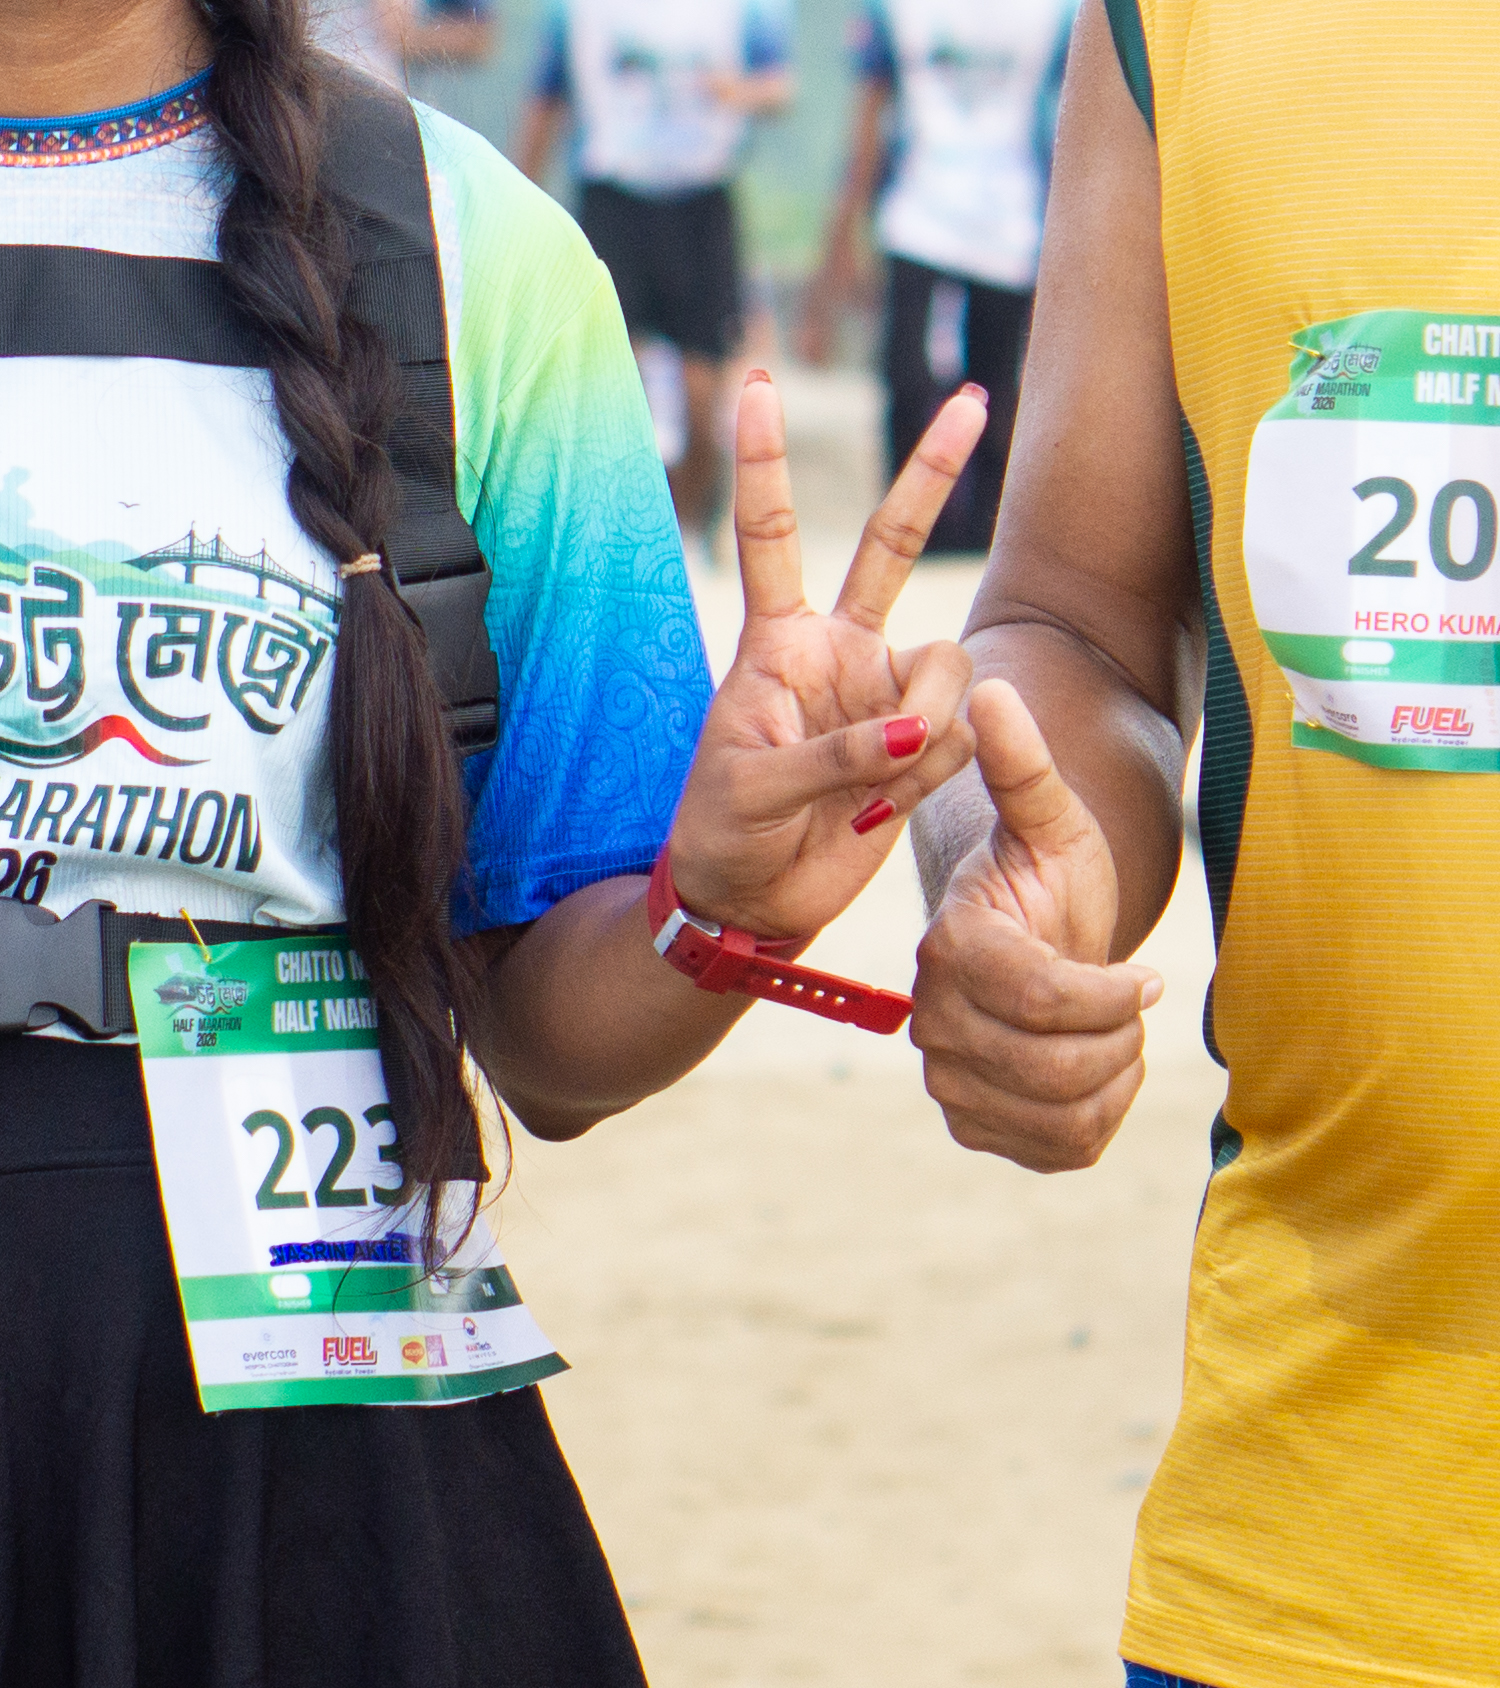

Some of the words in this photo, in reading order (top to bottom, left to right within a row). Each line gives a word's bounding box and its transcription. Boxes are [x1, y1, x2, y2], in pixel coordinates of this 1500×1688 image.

[1315, 382, 1371, 397] MARATHON
[1415, 370, 1481, 405] HALF
[1311, 396, 1336, 411] 2026
[1354, 610, 1430, 634] HERO
[1390, 705, 1474, 737] FUEL
[276, 949, 345, 985] CHATTO
[173, 1018, 195, 1033] HALF
[197, 1017, 242, 1031] MARATHON
[271, 999, 319, 1034] HALF
[196, 1032, 217, 1047] 2026
[241, 1102, 409, 1210] 223
[242, 1348, 297, 1362] evercare
[322, 1335, 378, 1367] FUEL
